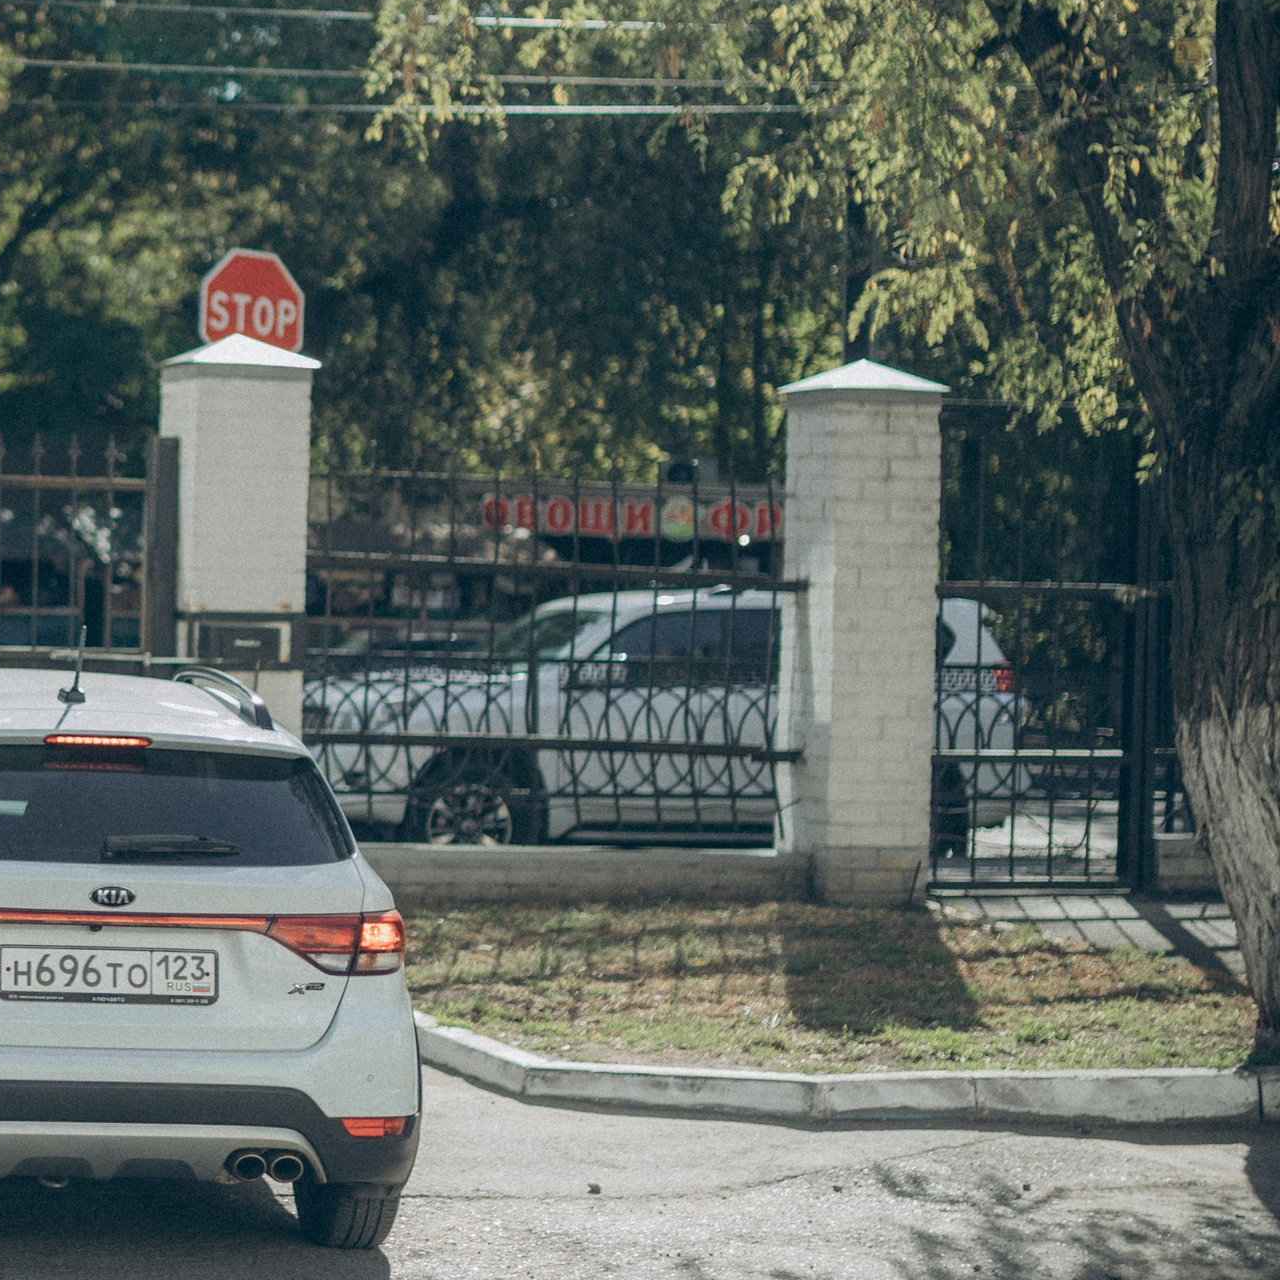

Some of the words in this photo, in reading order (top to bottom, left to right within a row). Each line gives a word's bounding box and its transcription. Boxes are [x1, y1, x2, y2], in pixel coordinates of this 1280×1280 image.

[208, 291, 297, 338] STOP
[96, 889, 130, 904] KIA
[167, 982, 192, 991] RUS
